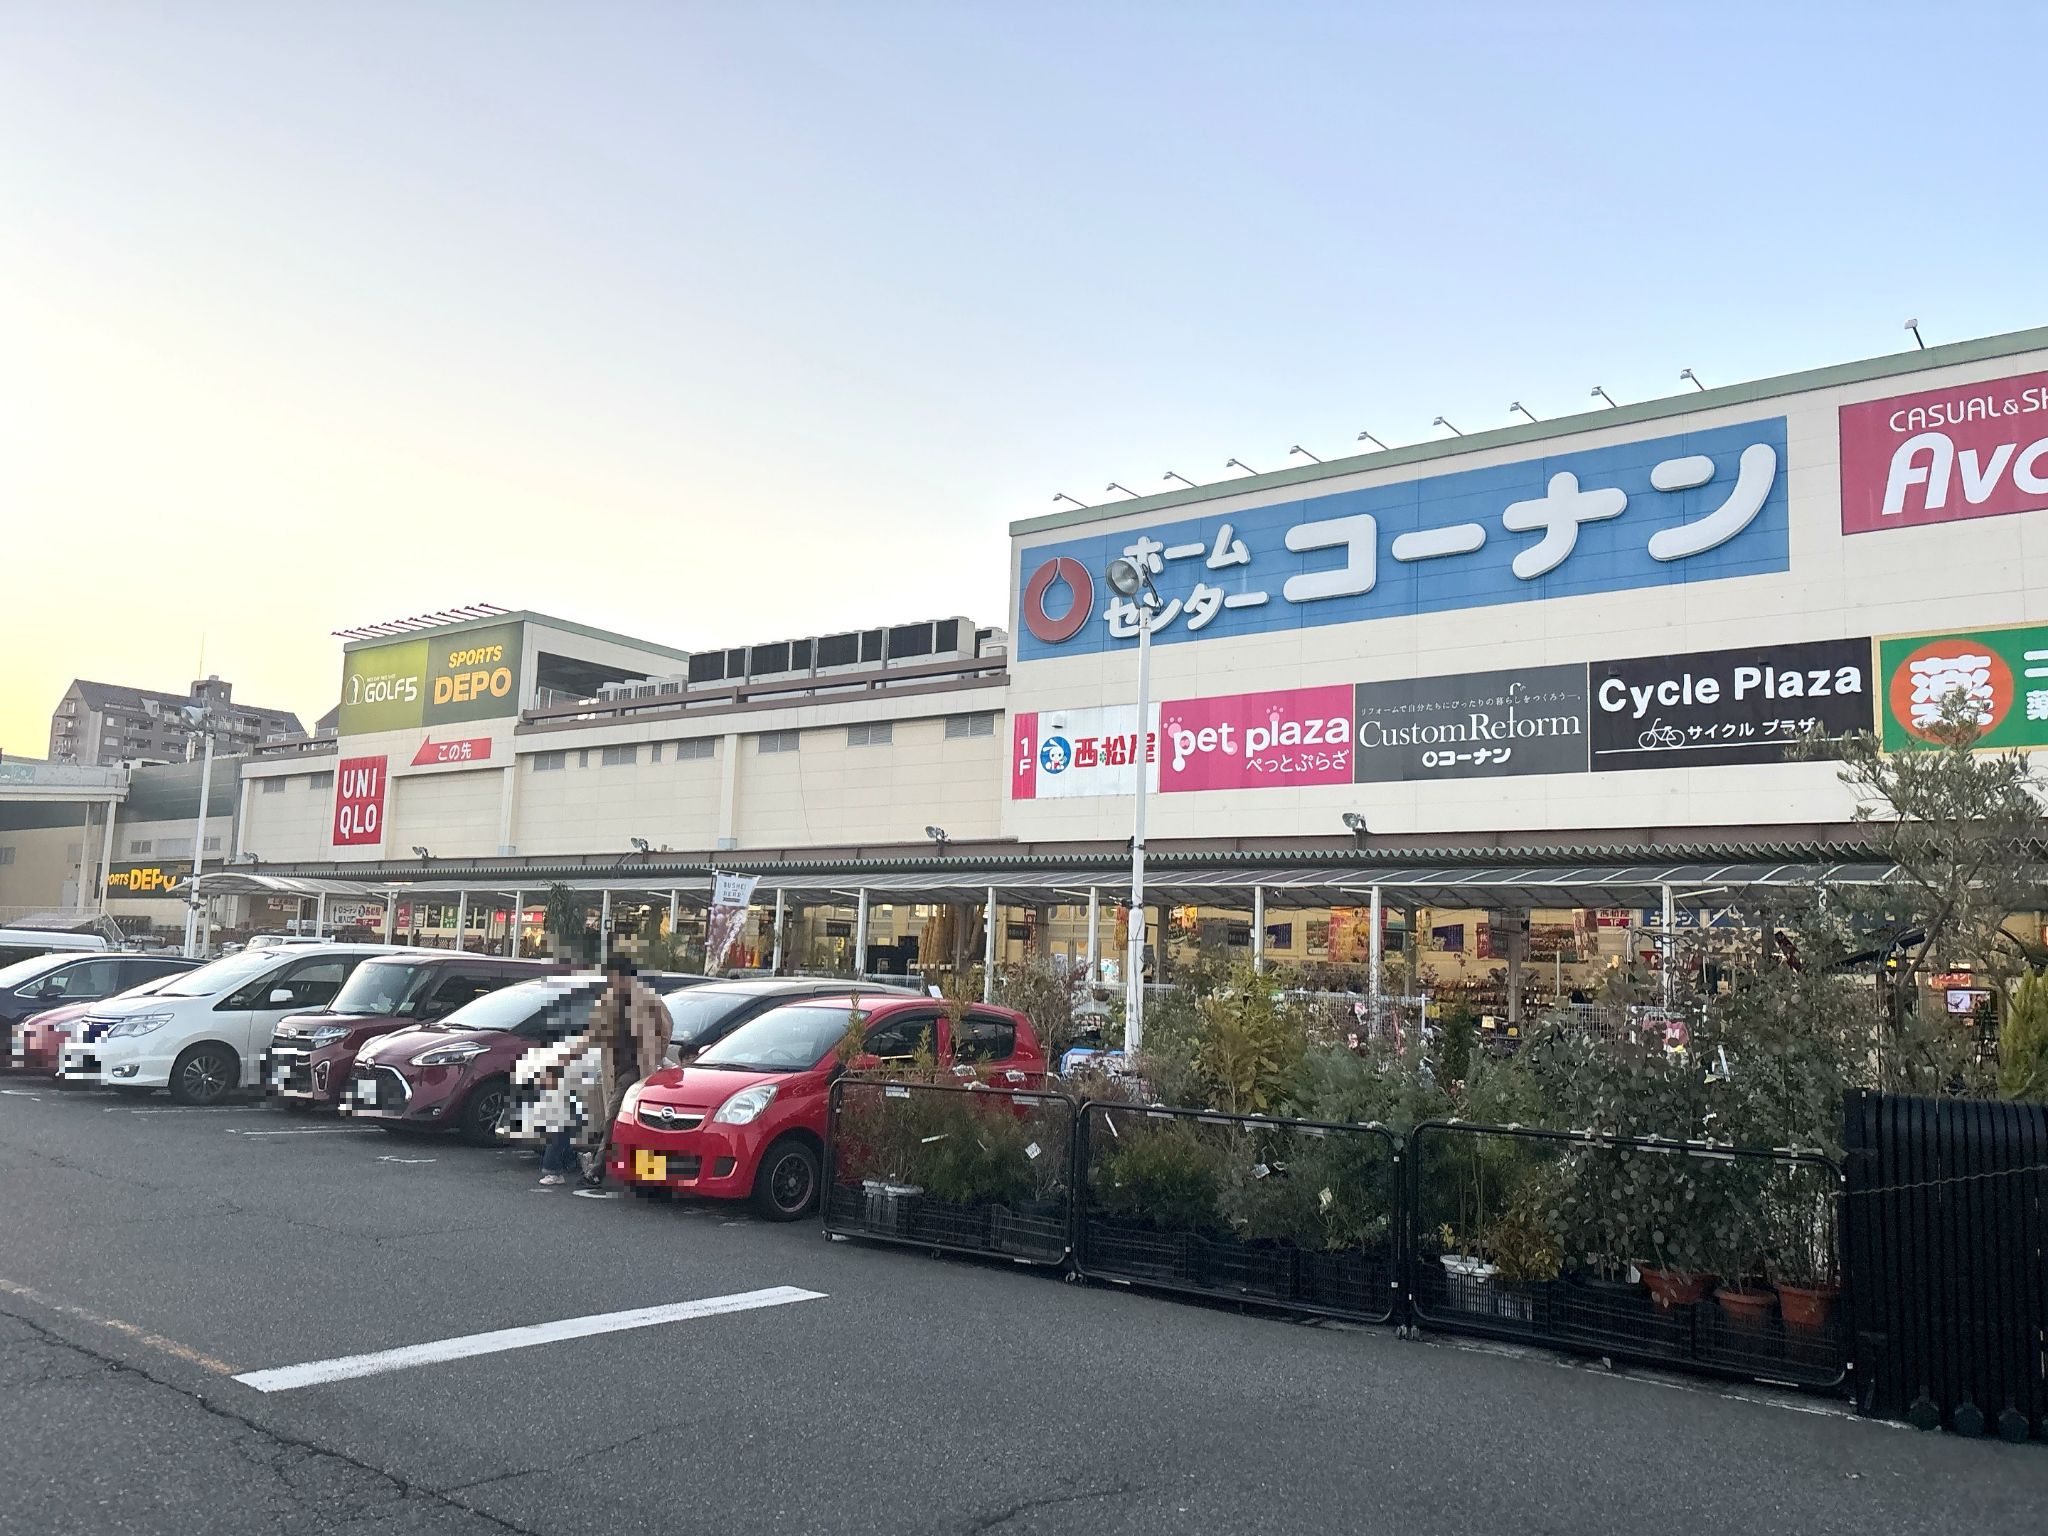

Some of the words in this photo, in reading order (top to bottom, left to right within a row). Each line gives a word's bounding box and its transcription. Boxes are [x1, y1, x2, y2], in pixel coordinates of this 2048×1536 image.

[1283, 443, 1777, 604] コーナン
[1123, 523, 1251, 574] ホーム
[1103, 583, 1269, 638] センター
[449, 645, 503, 669] SPORTS
[364, 676, 418, 703] GOLF5
[433, 667, 512, 705] DEPO
[1598, 673, 1720, 719] Cycle
[1734, 665, 1862, 701] Plaza
[1172, 721, 1239, 772] pet
[1245, 717, 1350, 758] plaza
[1687, 722, 1755, 740] サイクル
[1762, 717, 1816, 736] プラザ
[437, 741, 472, 762] この先
[1438, 747, 1512, 767] コーナン
[342, 768, 378, 799] UNI
[338, 803, 378, 840] QLO
